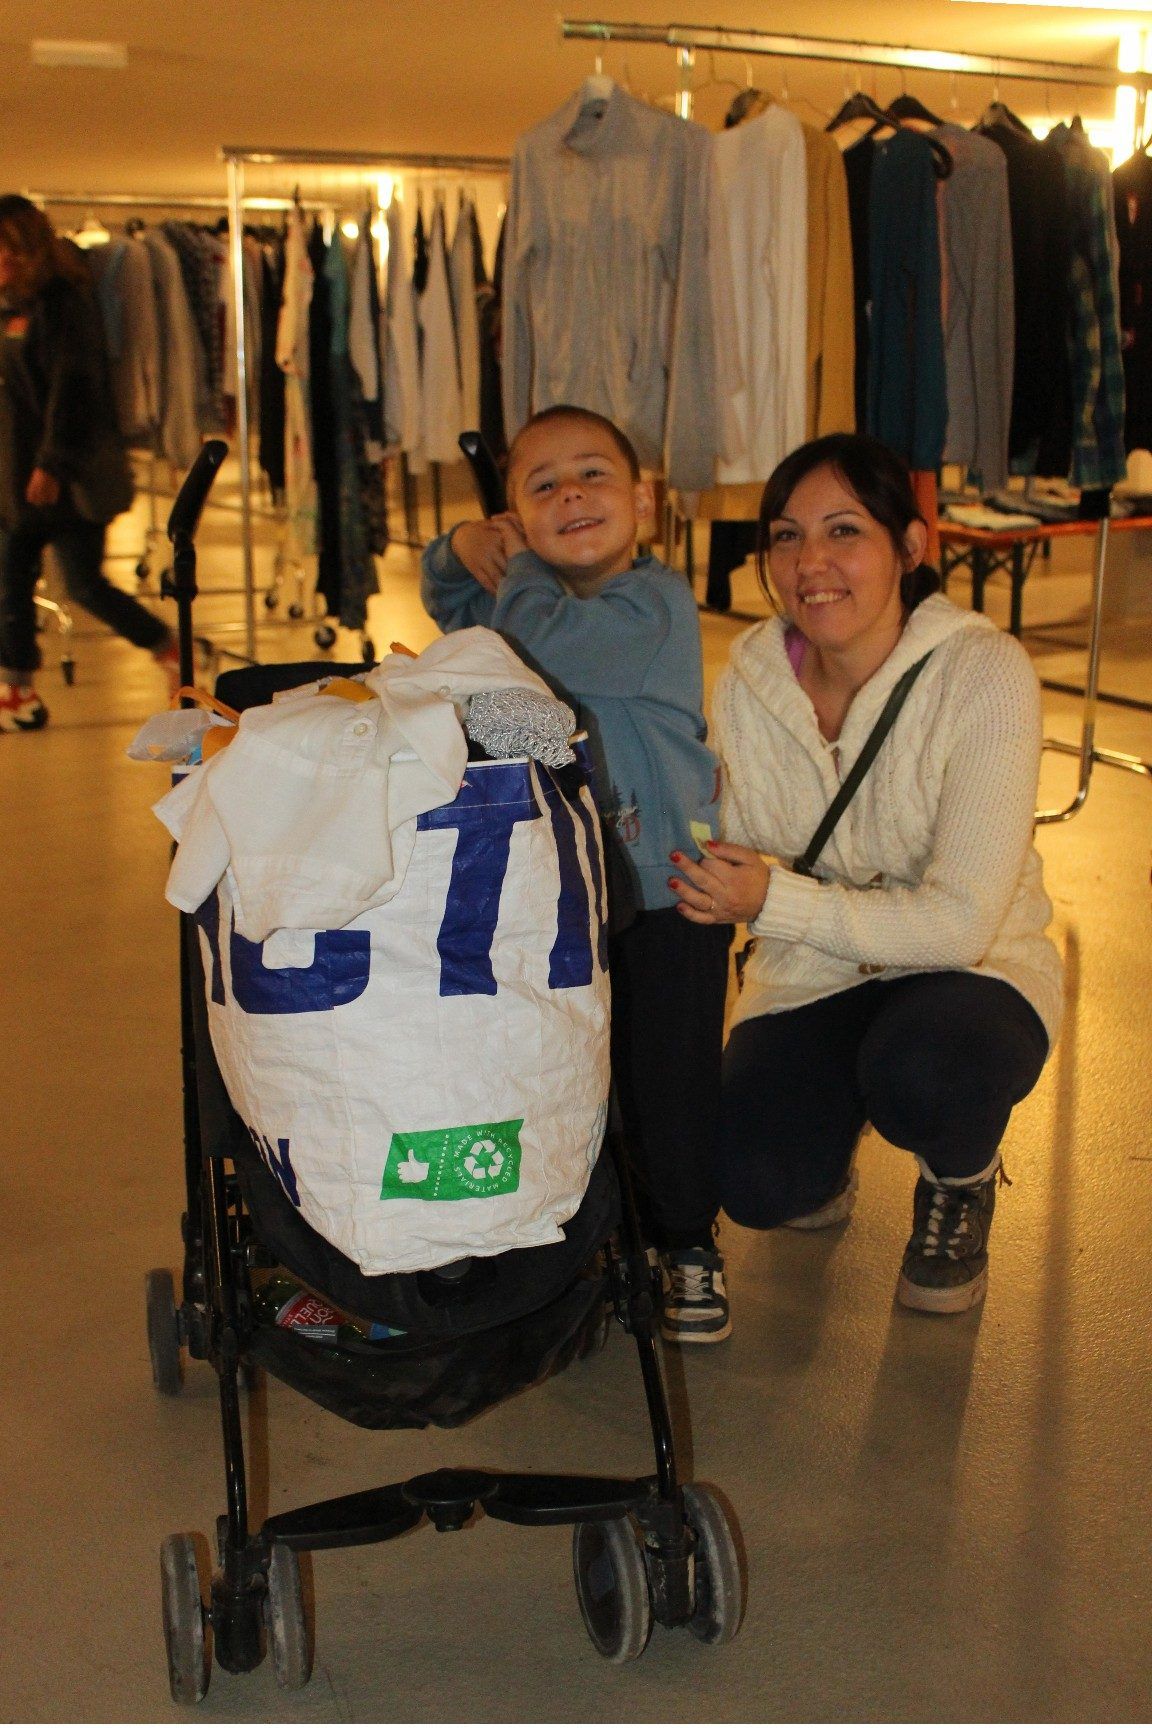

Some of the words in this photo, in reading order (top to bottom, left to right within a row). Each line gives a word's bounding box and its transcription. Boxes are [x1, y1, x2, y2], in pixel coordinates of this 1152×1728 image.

[453, 1134, 473, 1158] MADE
[476, 1129, 495, 1139] WITH
[453, 1166, 499, 1193] MATERIALS
